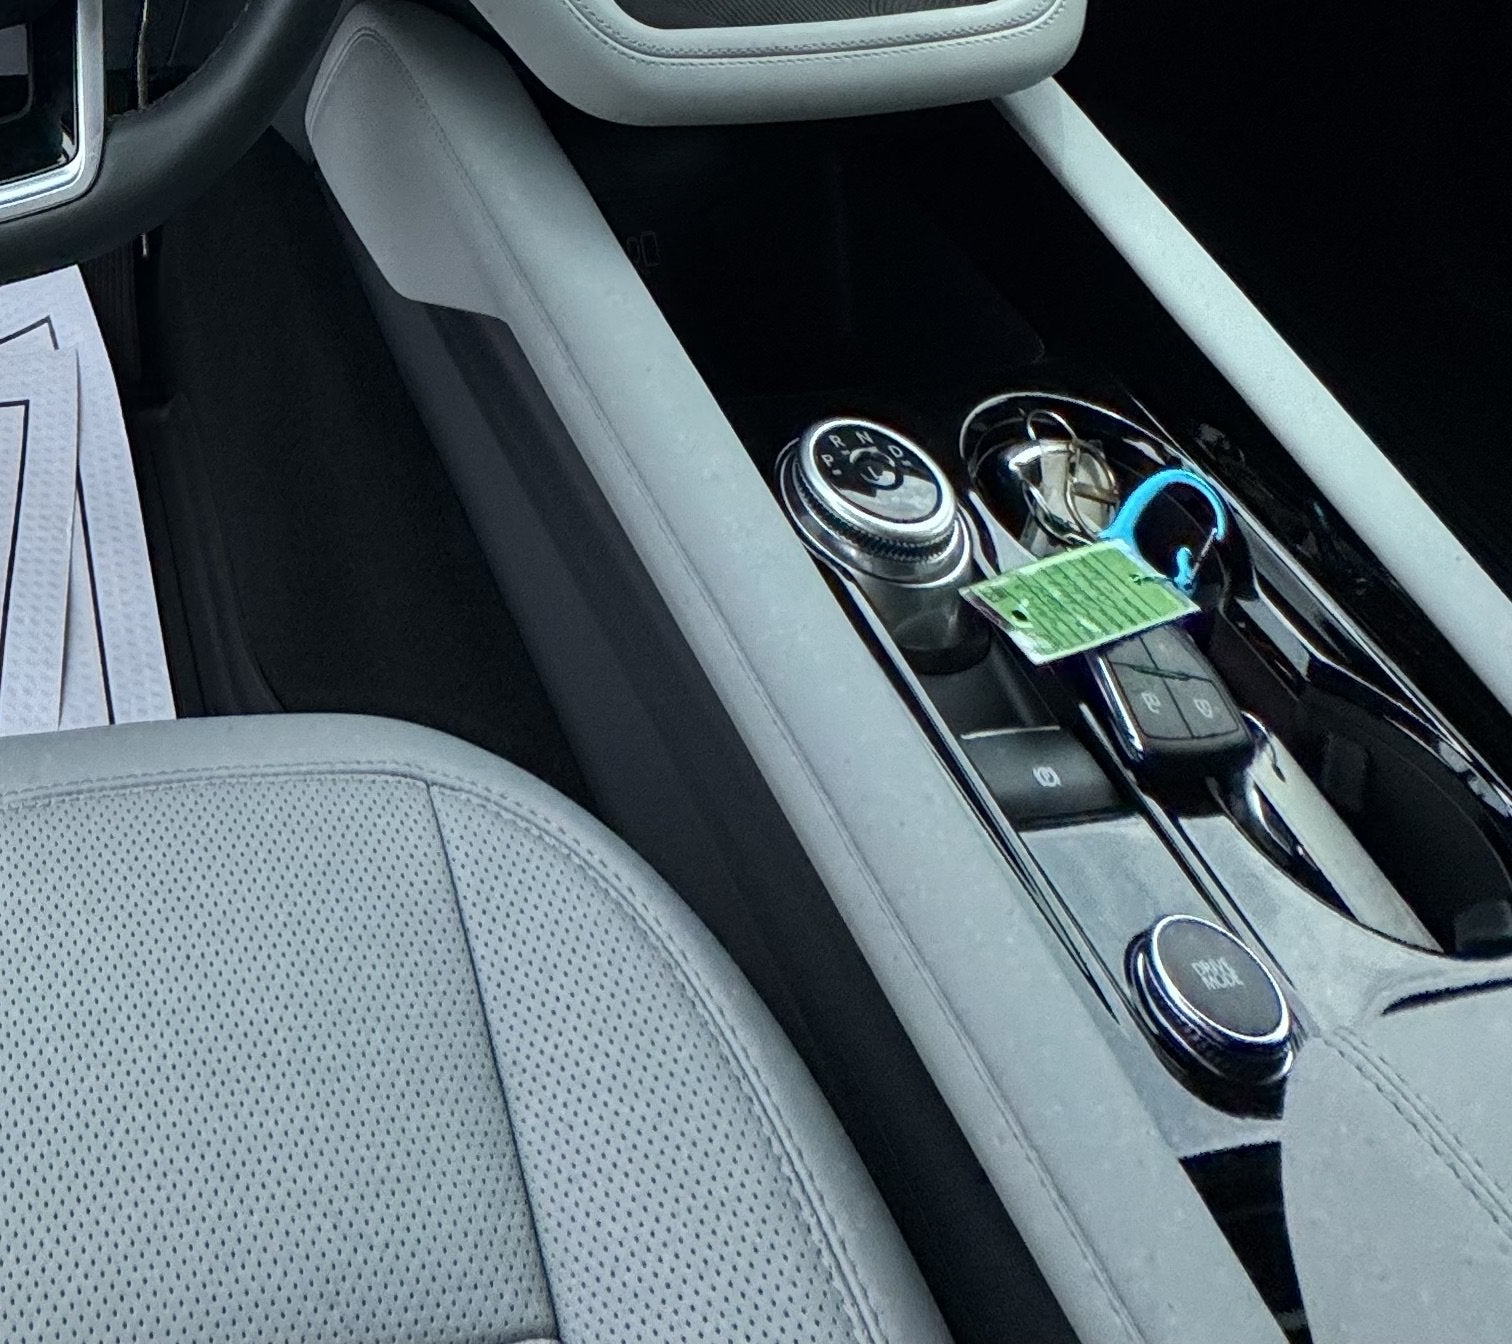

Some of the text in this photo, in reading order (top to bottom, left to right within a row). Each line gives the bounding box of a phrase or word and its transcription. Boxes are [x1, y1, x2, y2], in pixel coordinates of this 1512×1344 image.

[821, 431, 904, 468] P R N D
[1192, 957, 1235, 976] DRIVE
